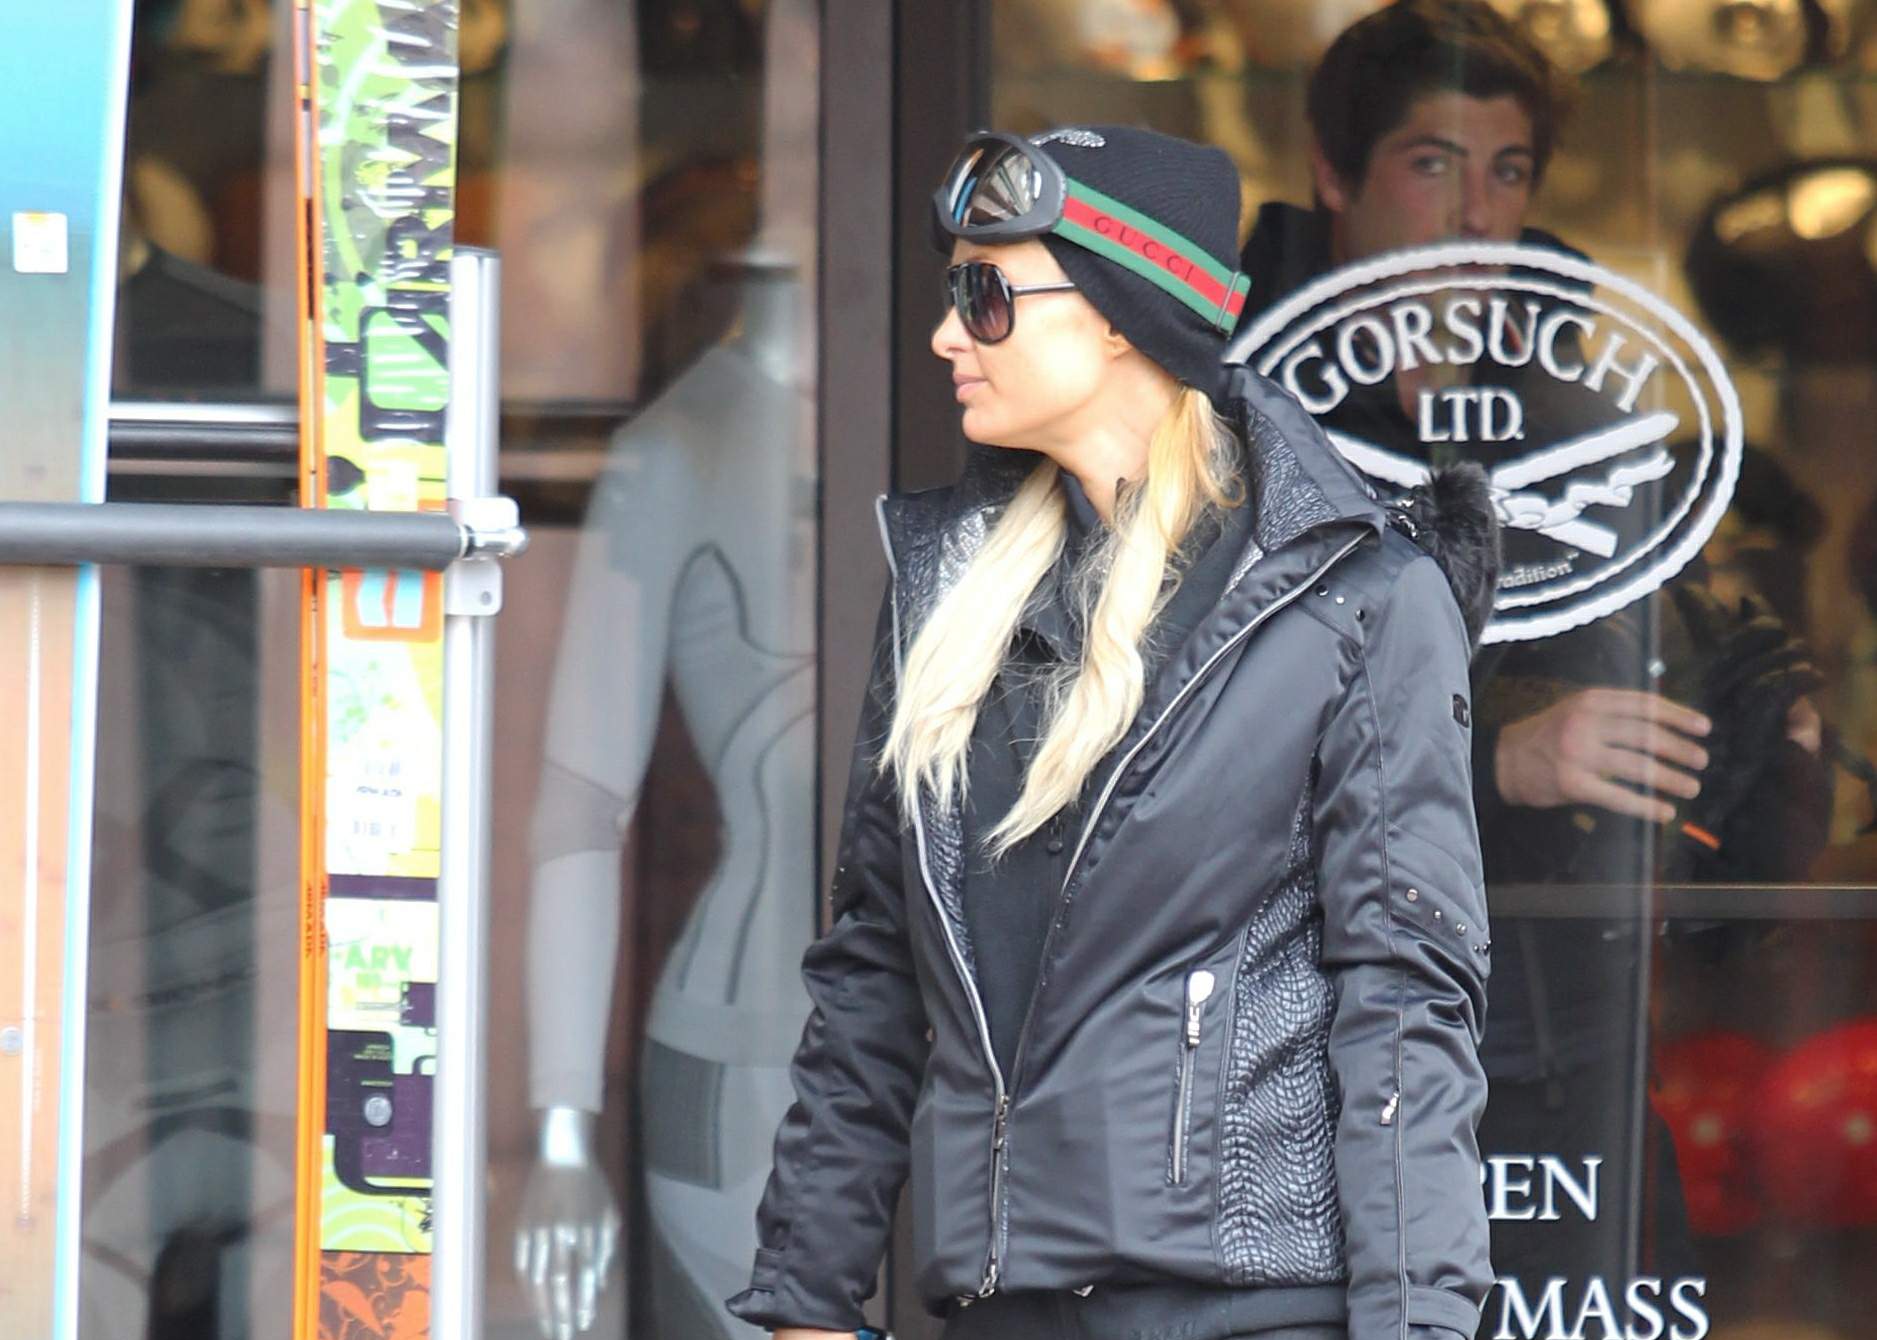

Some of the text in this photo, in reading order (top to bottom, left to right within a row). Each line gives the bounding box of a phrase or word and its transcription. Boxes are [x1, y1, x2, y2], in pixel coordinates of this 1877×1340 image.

[1094, 216, 1194, 283] GUCCI
[1284, 299, 1657, 414] GORSUCH
[1418, 387, 1525, 443] LTD.
[1480, 1155, 1603, 1222] EN
